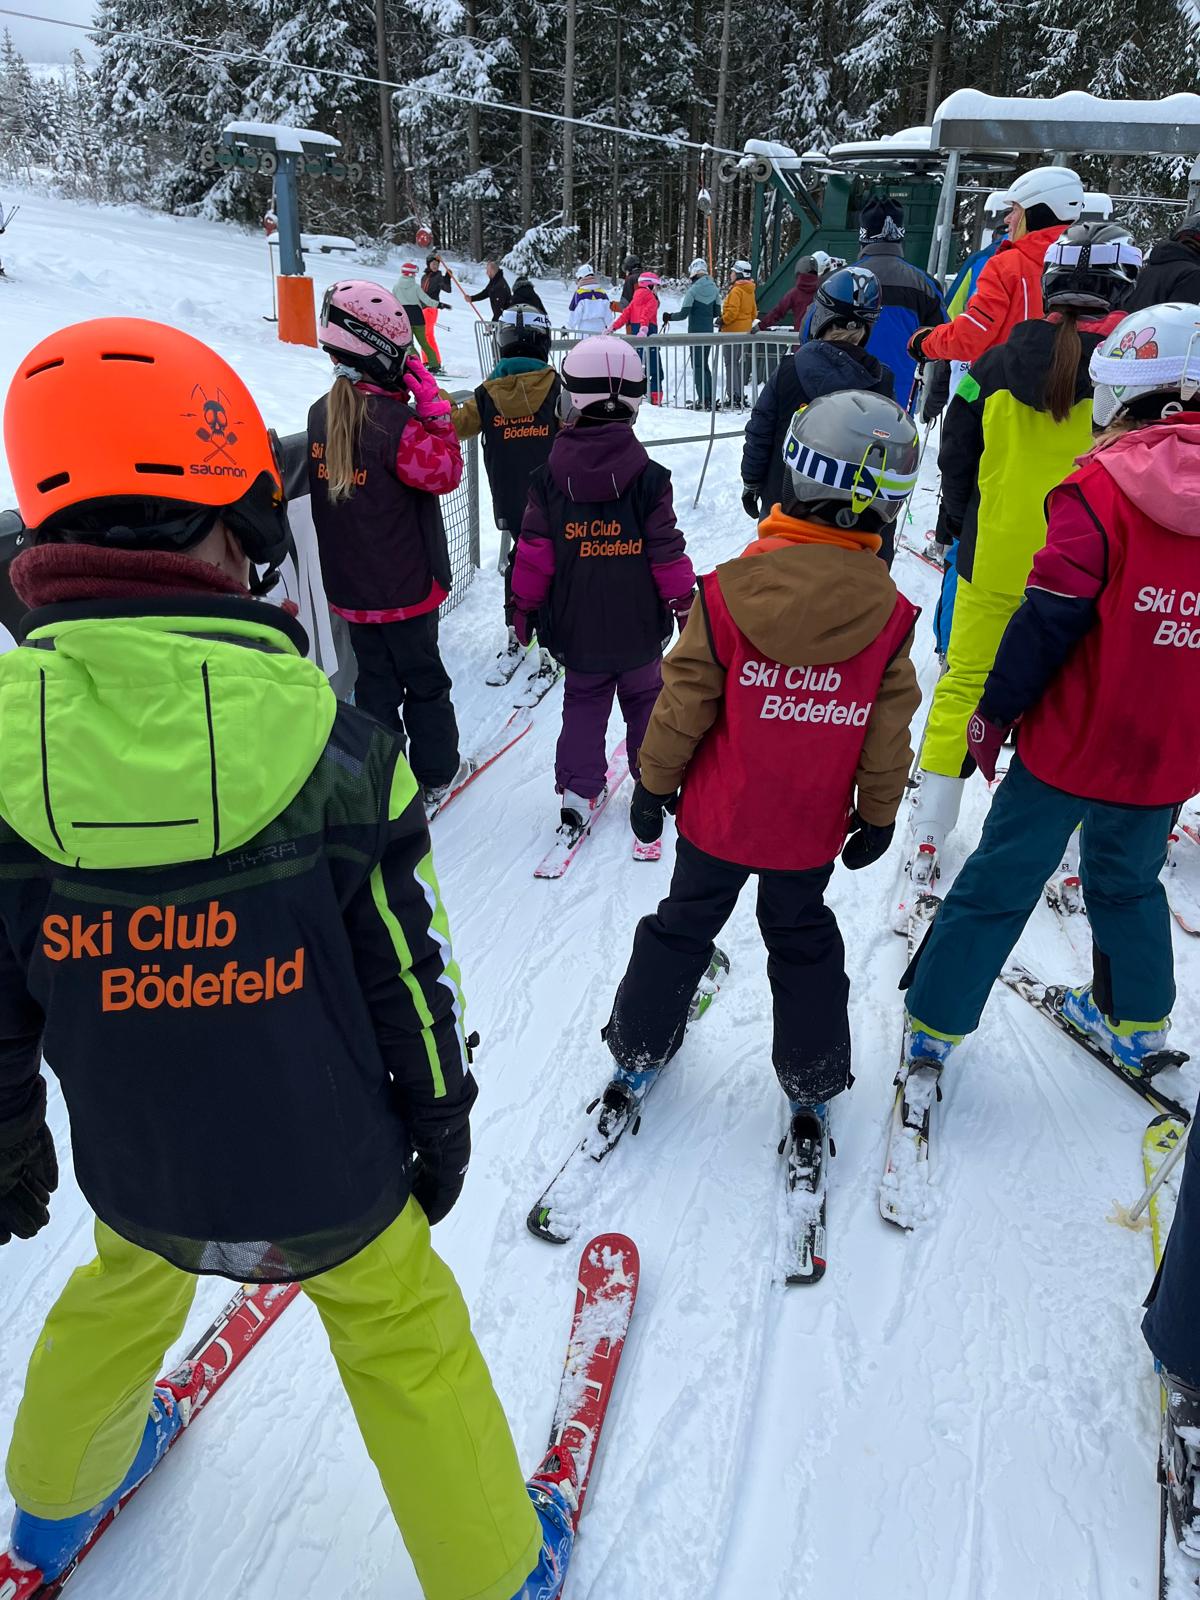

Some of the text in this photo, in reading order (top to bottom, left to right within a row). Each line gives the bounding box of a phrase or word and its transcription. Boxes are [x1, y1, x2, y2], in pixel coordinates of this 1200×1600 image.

[353, 328, 393, 354] ALPINA
[503, 424, 549, 440] Bödefeld
[311, 442, 325, 459] Ski
[564, 519, 621, 540] Ski Club
[580, 538, 642, 557] Bödefeld
[1134, 586, 1176, 613] Ski
[739, 660, 842, 692] Ski Club
[760, 694, 872, 727] Bödefeld
[42, 901, 237, 961] Ski Club
[102, 947, 304, 1012] Bödefeld
